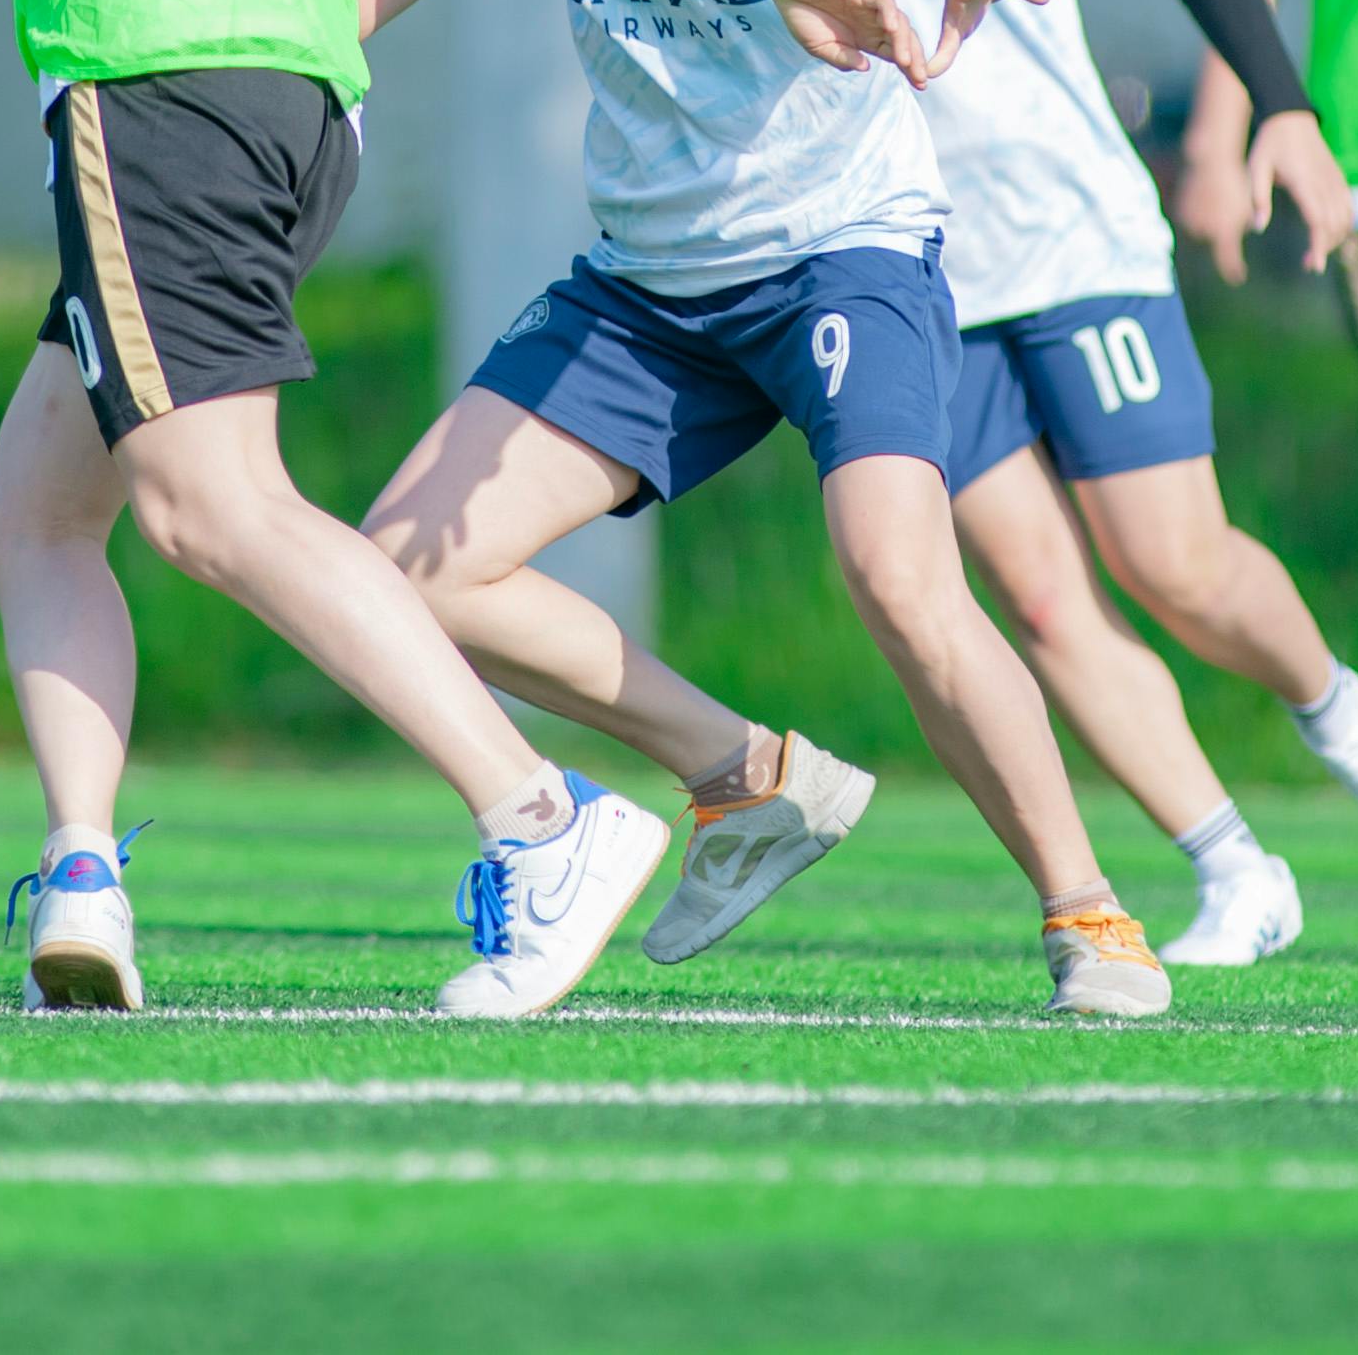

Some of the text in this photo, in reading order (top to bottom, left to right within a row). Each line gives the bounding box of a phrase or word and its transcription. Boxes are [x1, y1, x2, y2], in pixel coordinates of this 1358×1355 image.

[603, 14, 753, 40] IRWAYS
[811, 312, 851, 399] 9
[1071, 315, 1162, 415] 10
